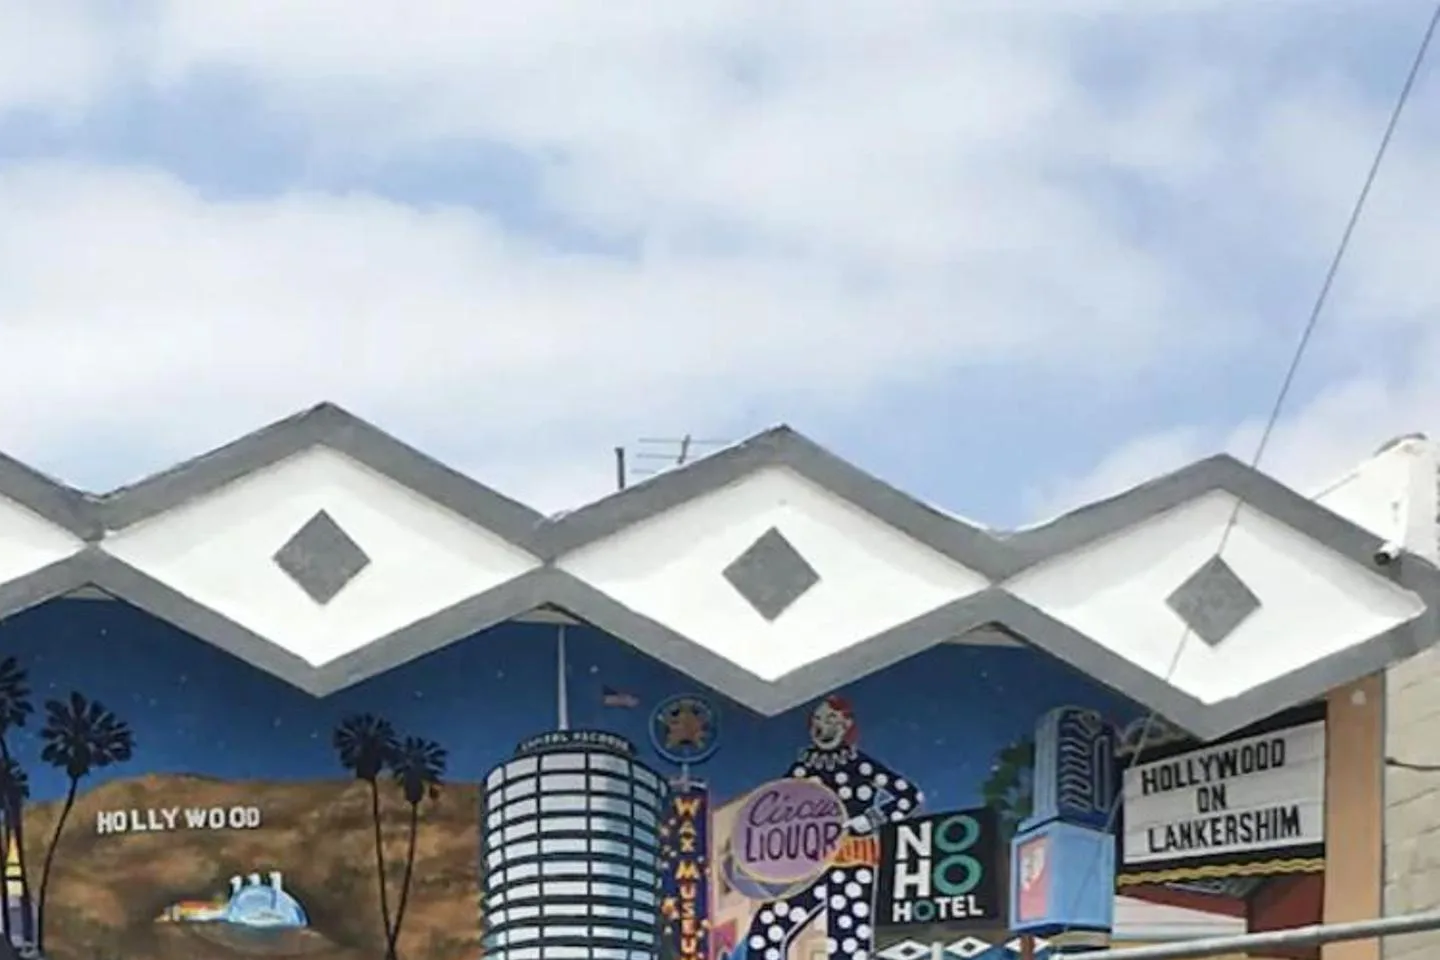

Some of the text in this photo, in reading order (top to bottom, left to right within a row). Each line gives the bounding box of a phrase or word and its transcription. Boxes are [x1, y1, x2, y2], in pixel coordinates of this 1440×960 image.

[1141, 738, 1286, 797] HOLLYWOOD
[1197, 783, 1227, 814] ON
[896, 815, 979, 860] NO
[1147, 805, 1301, 853] LANKERSHIM
[893, 854, 982, 900] HO
[892, 894, 984, 922] HOTEL
